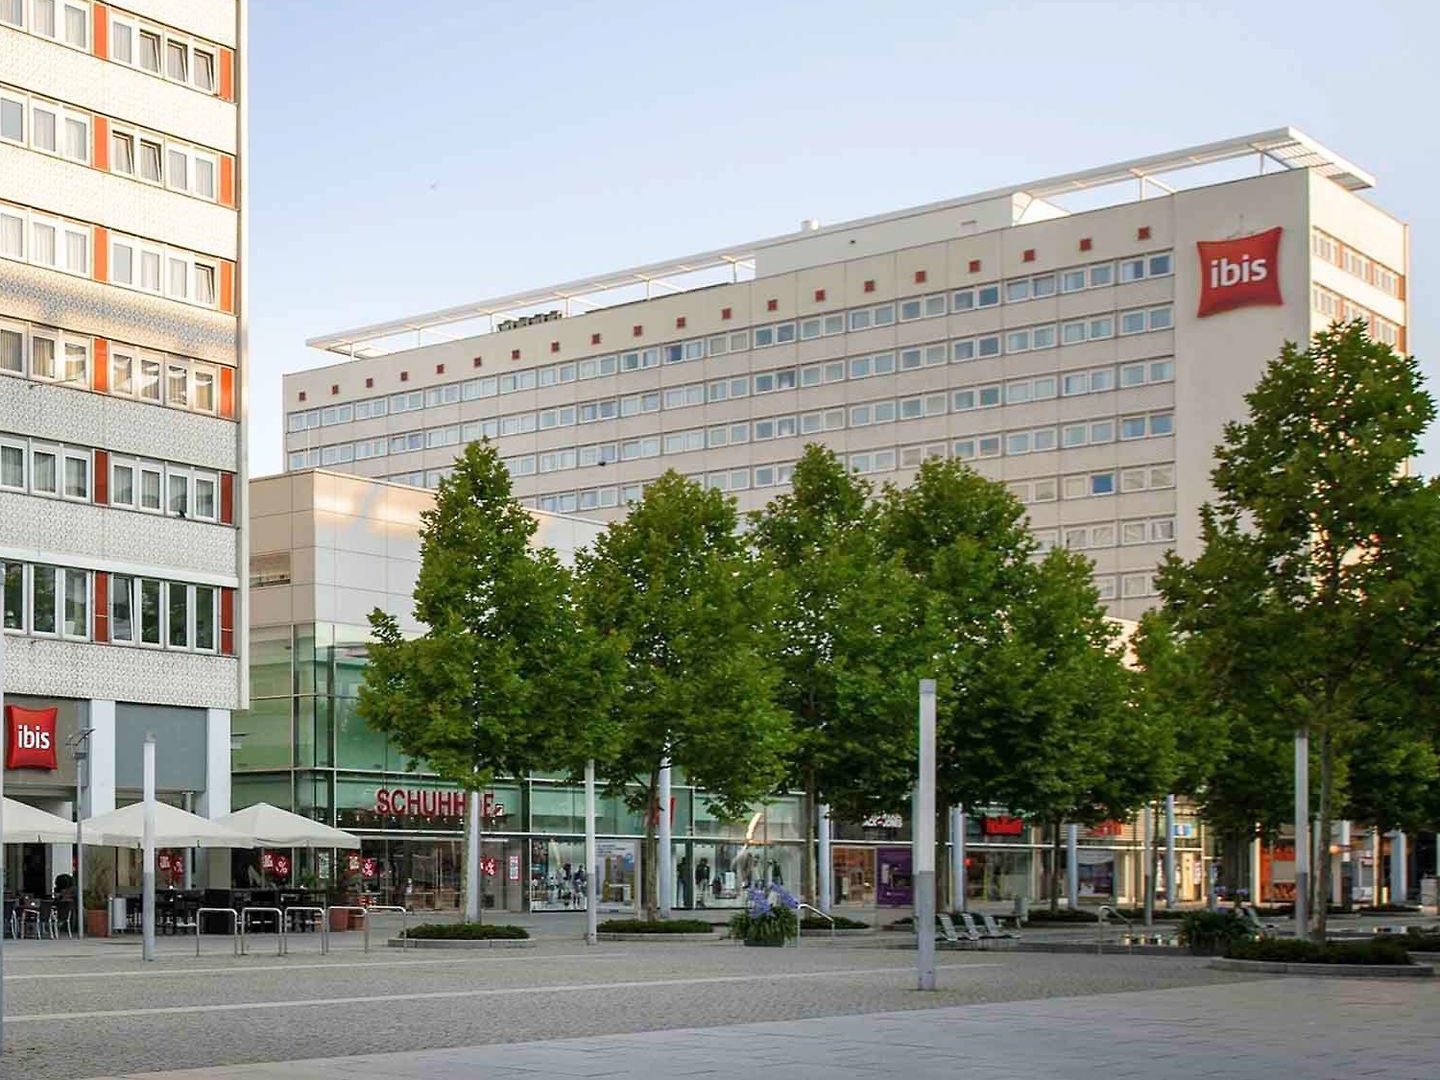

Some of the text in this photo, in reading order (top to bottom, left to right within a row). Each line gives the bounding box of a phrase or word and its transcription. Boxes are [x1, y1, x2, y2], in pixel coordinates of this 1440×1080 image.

[1211, 254, 1267, 288] ibis
[18, 724, 50, 749] ibis
[375, 787, 494, 818] SCHUHHF
